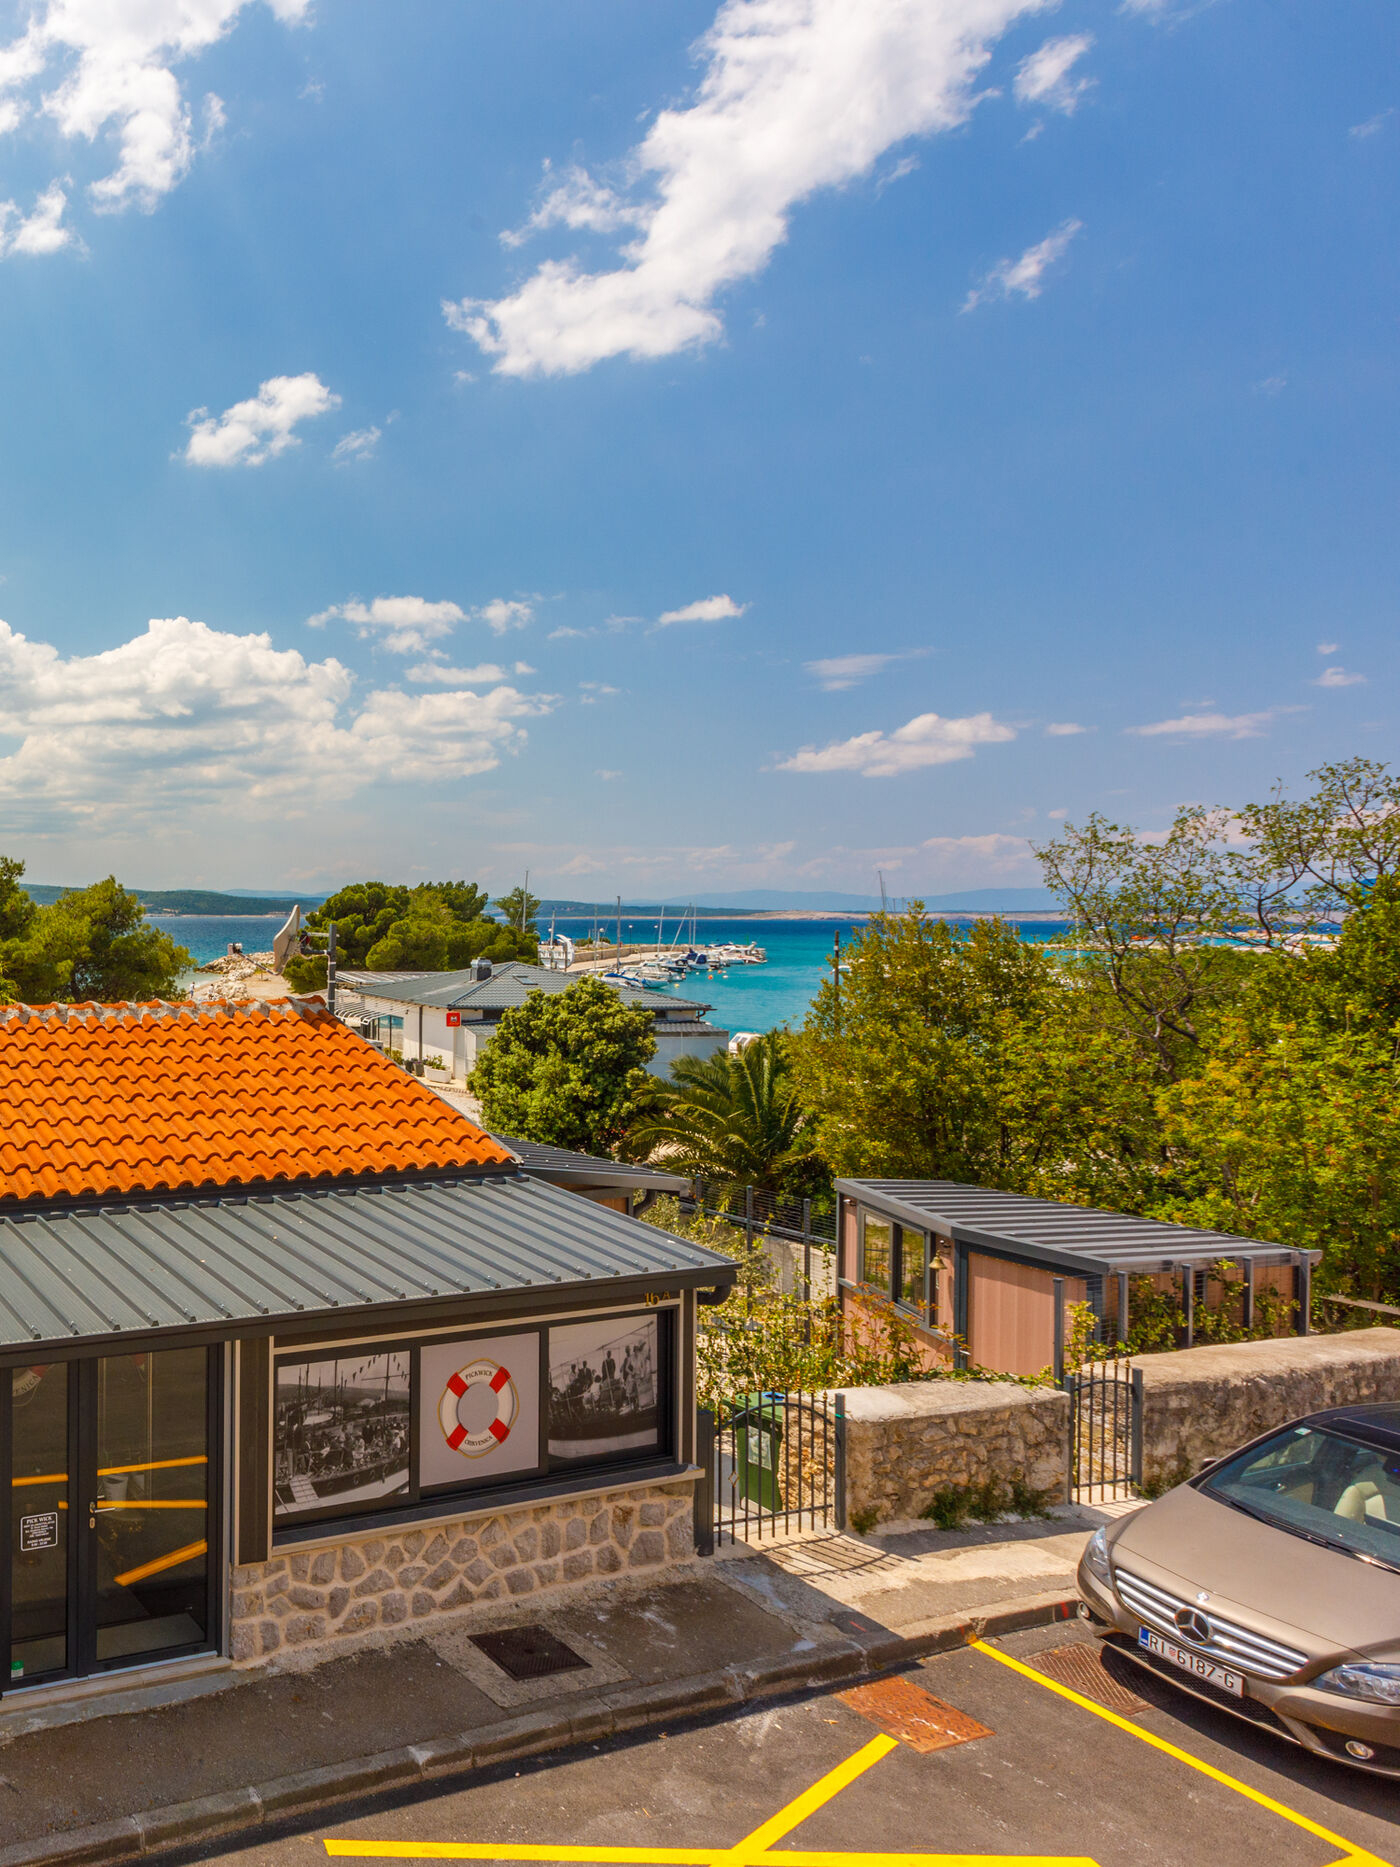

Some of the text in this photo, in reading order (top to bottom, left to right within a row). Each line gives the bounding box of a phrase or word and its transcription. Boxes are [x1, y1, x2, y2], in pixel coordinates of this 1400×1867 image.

[465, 1369, 493, 1380] PICKWICK
[1149, 1634, 1235, 1689] RI 6187-G
